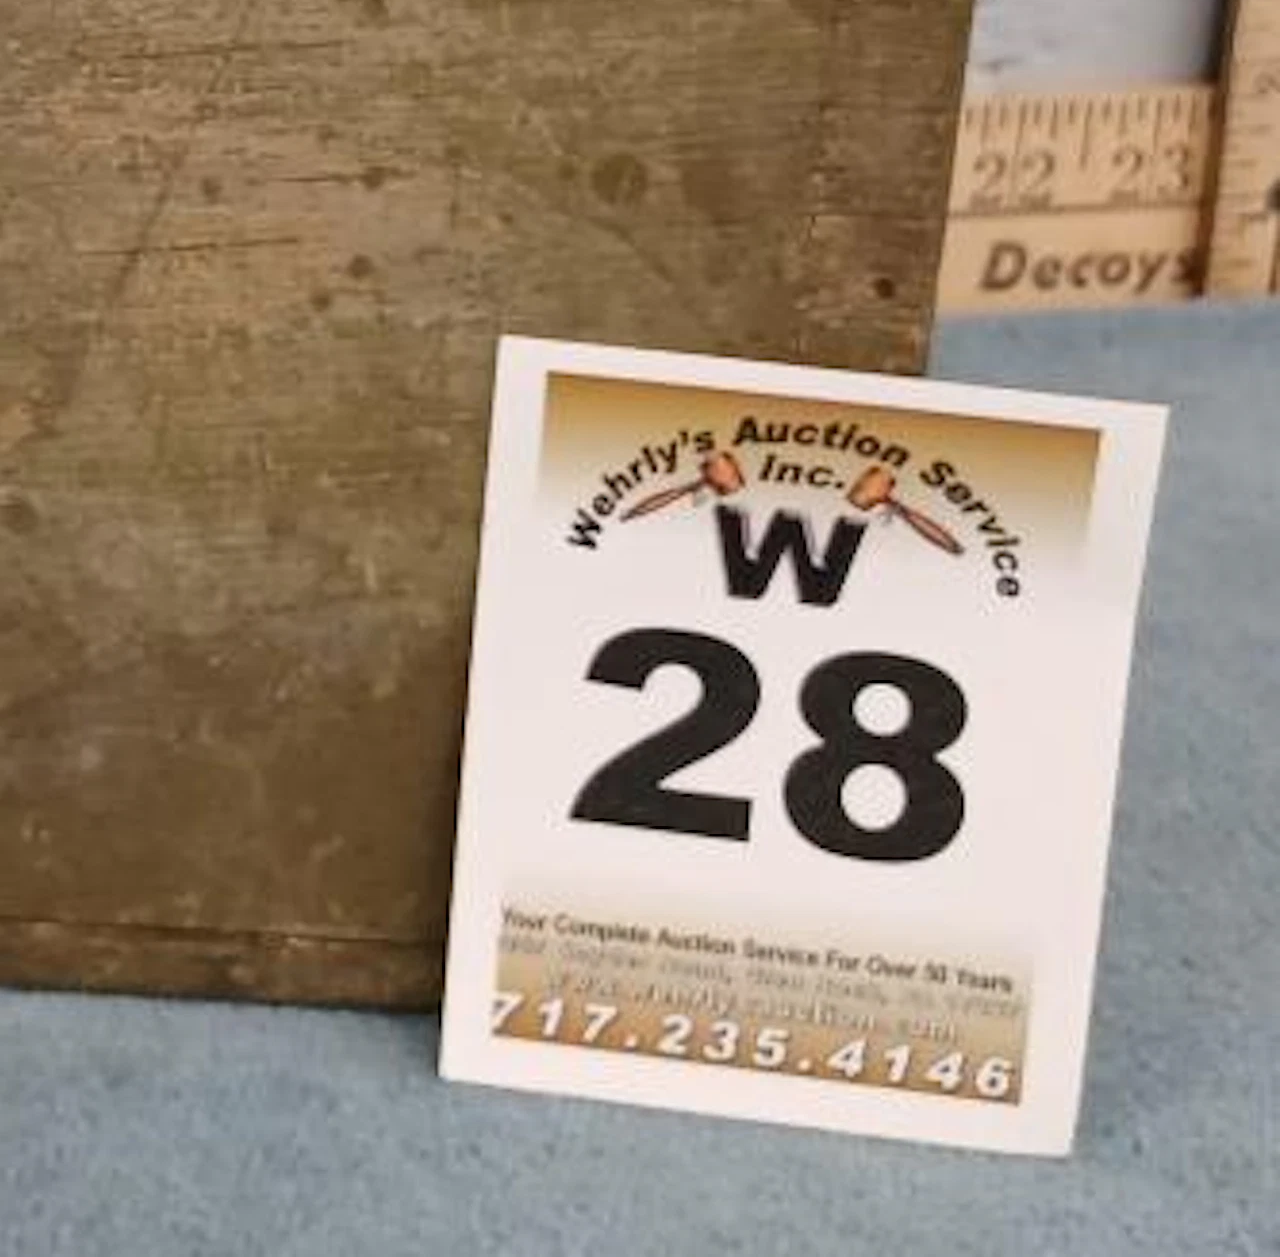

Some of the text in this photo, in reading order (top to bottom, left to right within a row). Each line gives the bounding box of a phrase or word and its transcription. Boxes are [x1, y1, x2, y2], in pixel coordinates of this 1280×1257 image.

[972, 143, 1191, 210] 22 23
[567, 416, 1020, 599] Wehrly's Auction Service
[758, 454, 845, 489] Inc.
[713, 504, 869, 607] W
[569, 627, 971, 864] 28
[502, 909, 547, 930] Your
[553, 913, 651, 943] Complete
[657, 928, 737, 955] Auction
[741, 939, 819, 962] Service
[827, 949, 861, 970] For
[865, 953, 917, 978] Over
[955, 968, 1014, 993] Years
[494, 992, 1016, 1097] 717.235.4146
